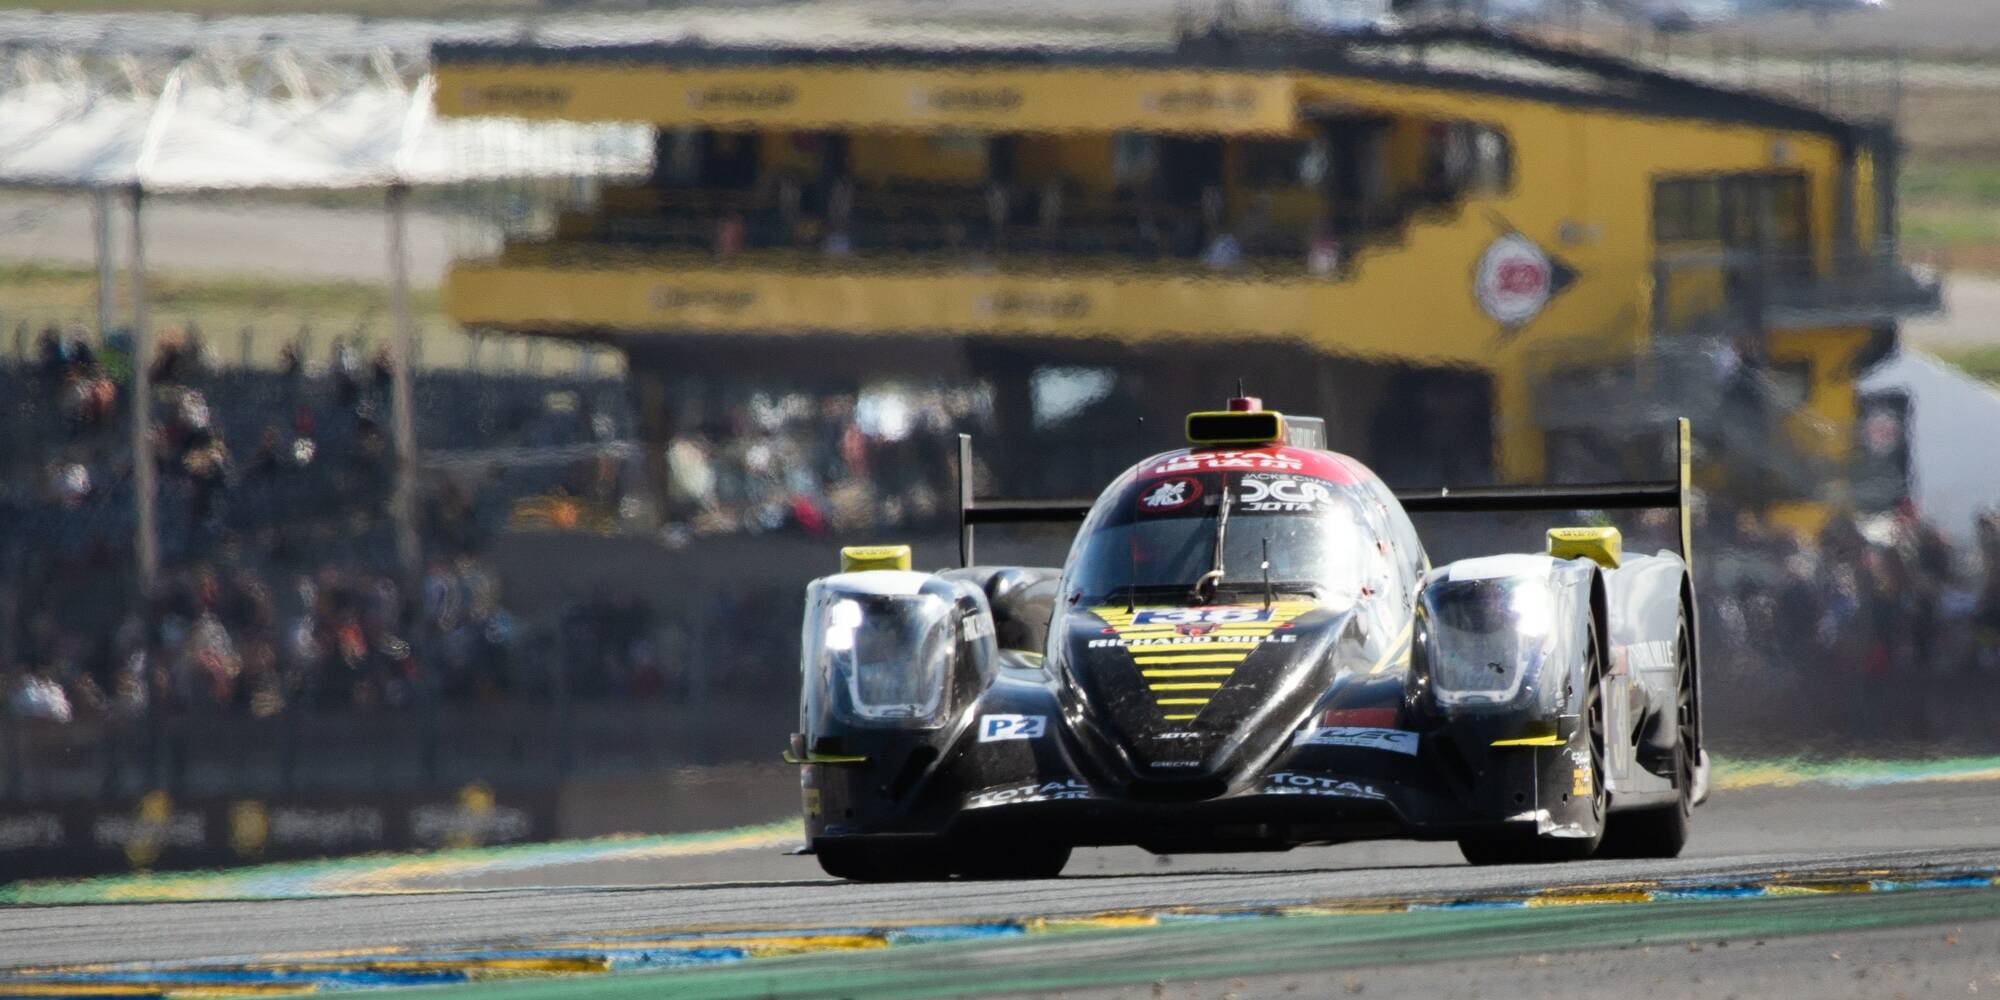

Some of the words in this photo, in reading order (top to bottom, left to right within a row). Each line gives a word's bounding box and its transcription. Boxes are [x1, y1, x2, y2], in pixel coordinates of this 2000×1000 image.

[1168, 451, 1301, 463] TOTAL
[1241, 502, 1313, 511] JOTA
[1088, 636, 1206, 649] RICHARD
[1212, 633, 1297, 644] MILLE
[987, 718, 1040, 737] P2
[970, 778, 1089, 803] TOTAL
[1267, 772, 1386, 797] TOTAL
